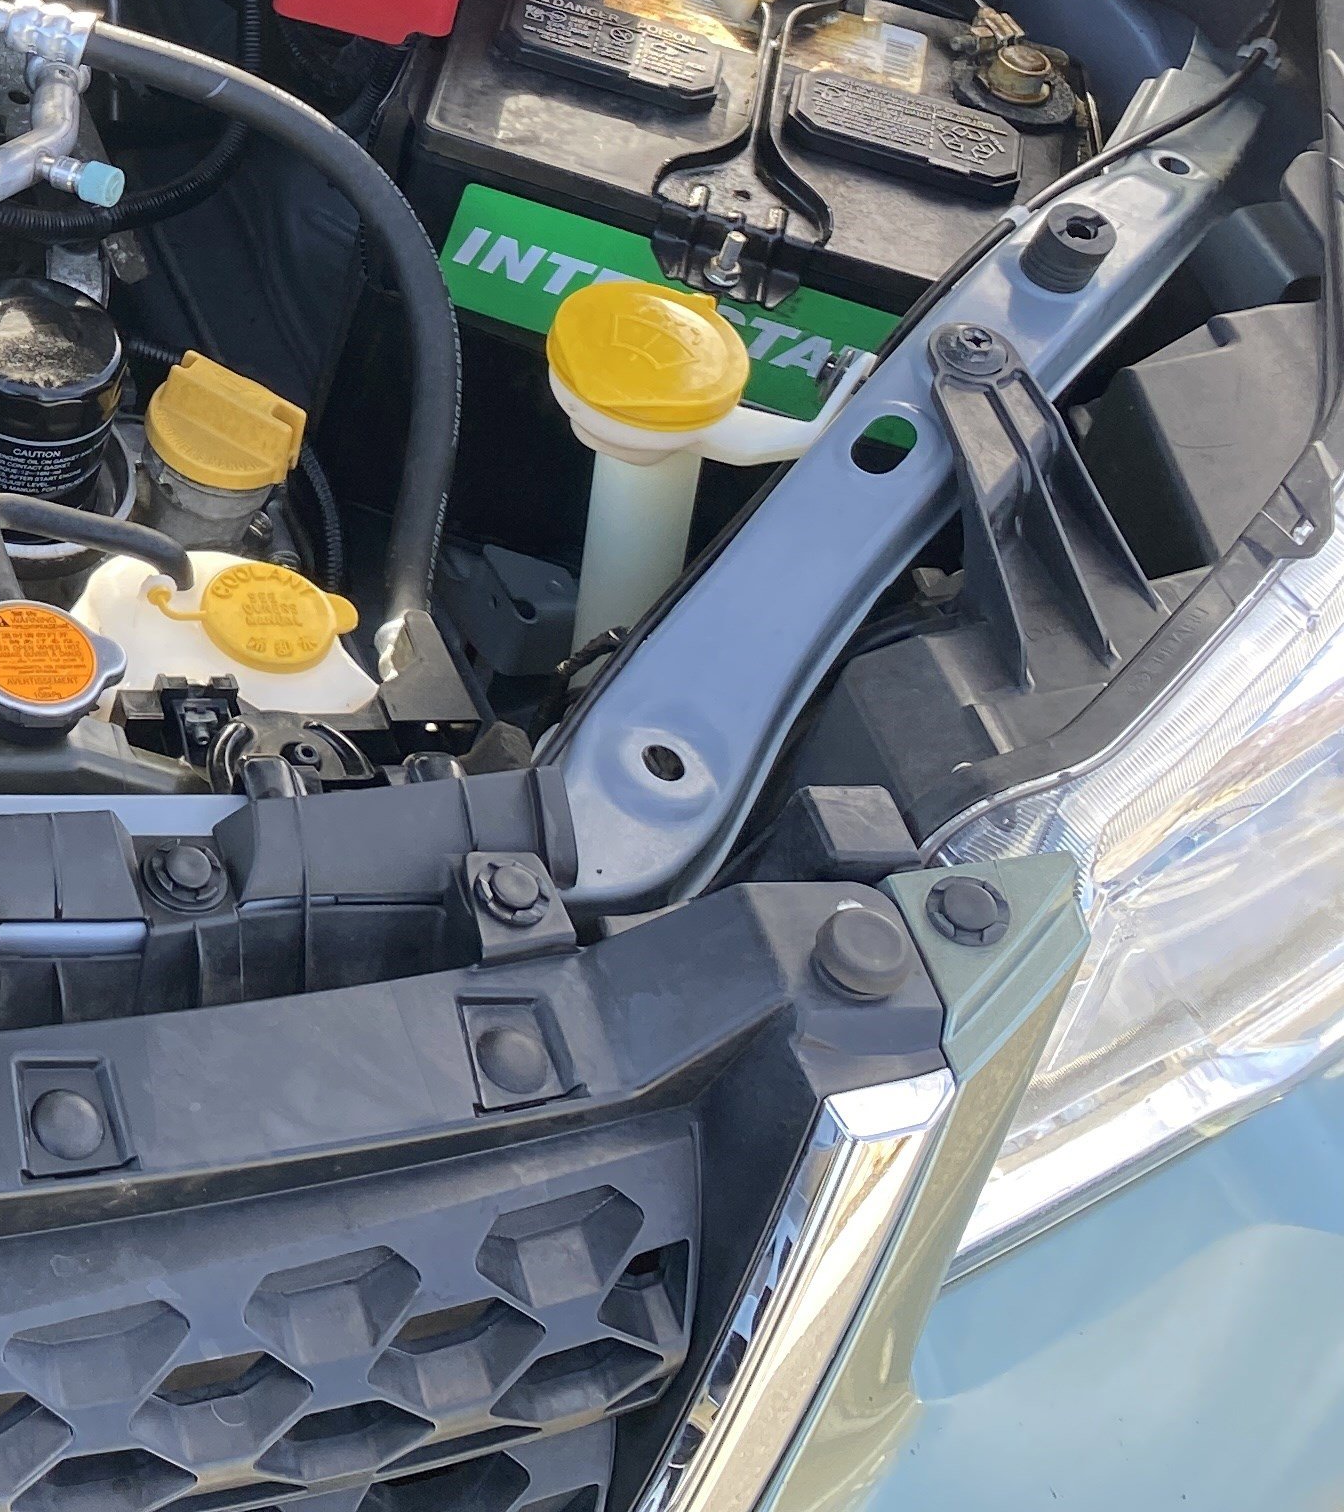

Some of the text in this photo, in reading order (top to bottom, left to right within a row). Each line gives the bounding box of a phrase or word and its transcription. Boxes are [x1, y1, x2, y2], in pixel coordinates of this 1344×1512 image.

[636, 21, 697, 45] POISON
[452, 225, 862, 380] INTTA
[13, 448, 62, 459] CAUTION
[7, 461, 43, 471] CONTACT
[211, 565, 317, 600] COOLANT
[247, 591, 278, 604] SEE
[12, 616, 57, 625] WARNING
[245, 614, 303, 627] MANUAL
